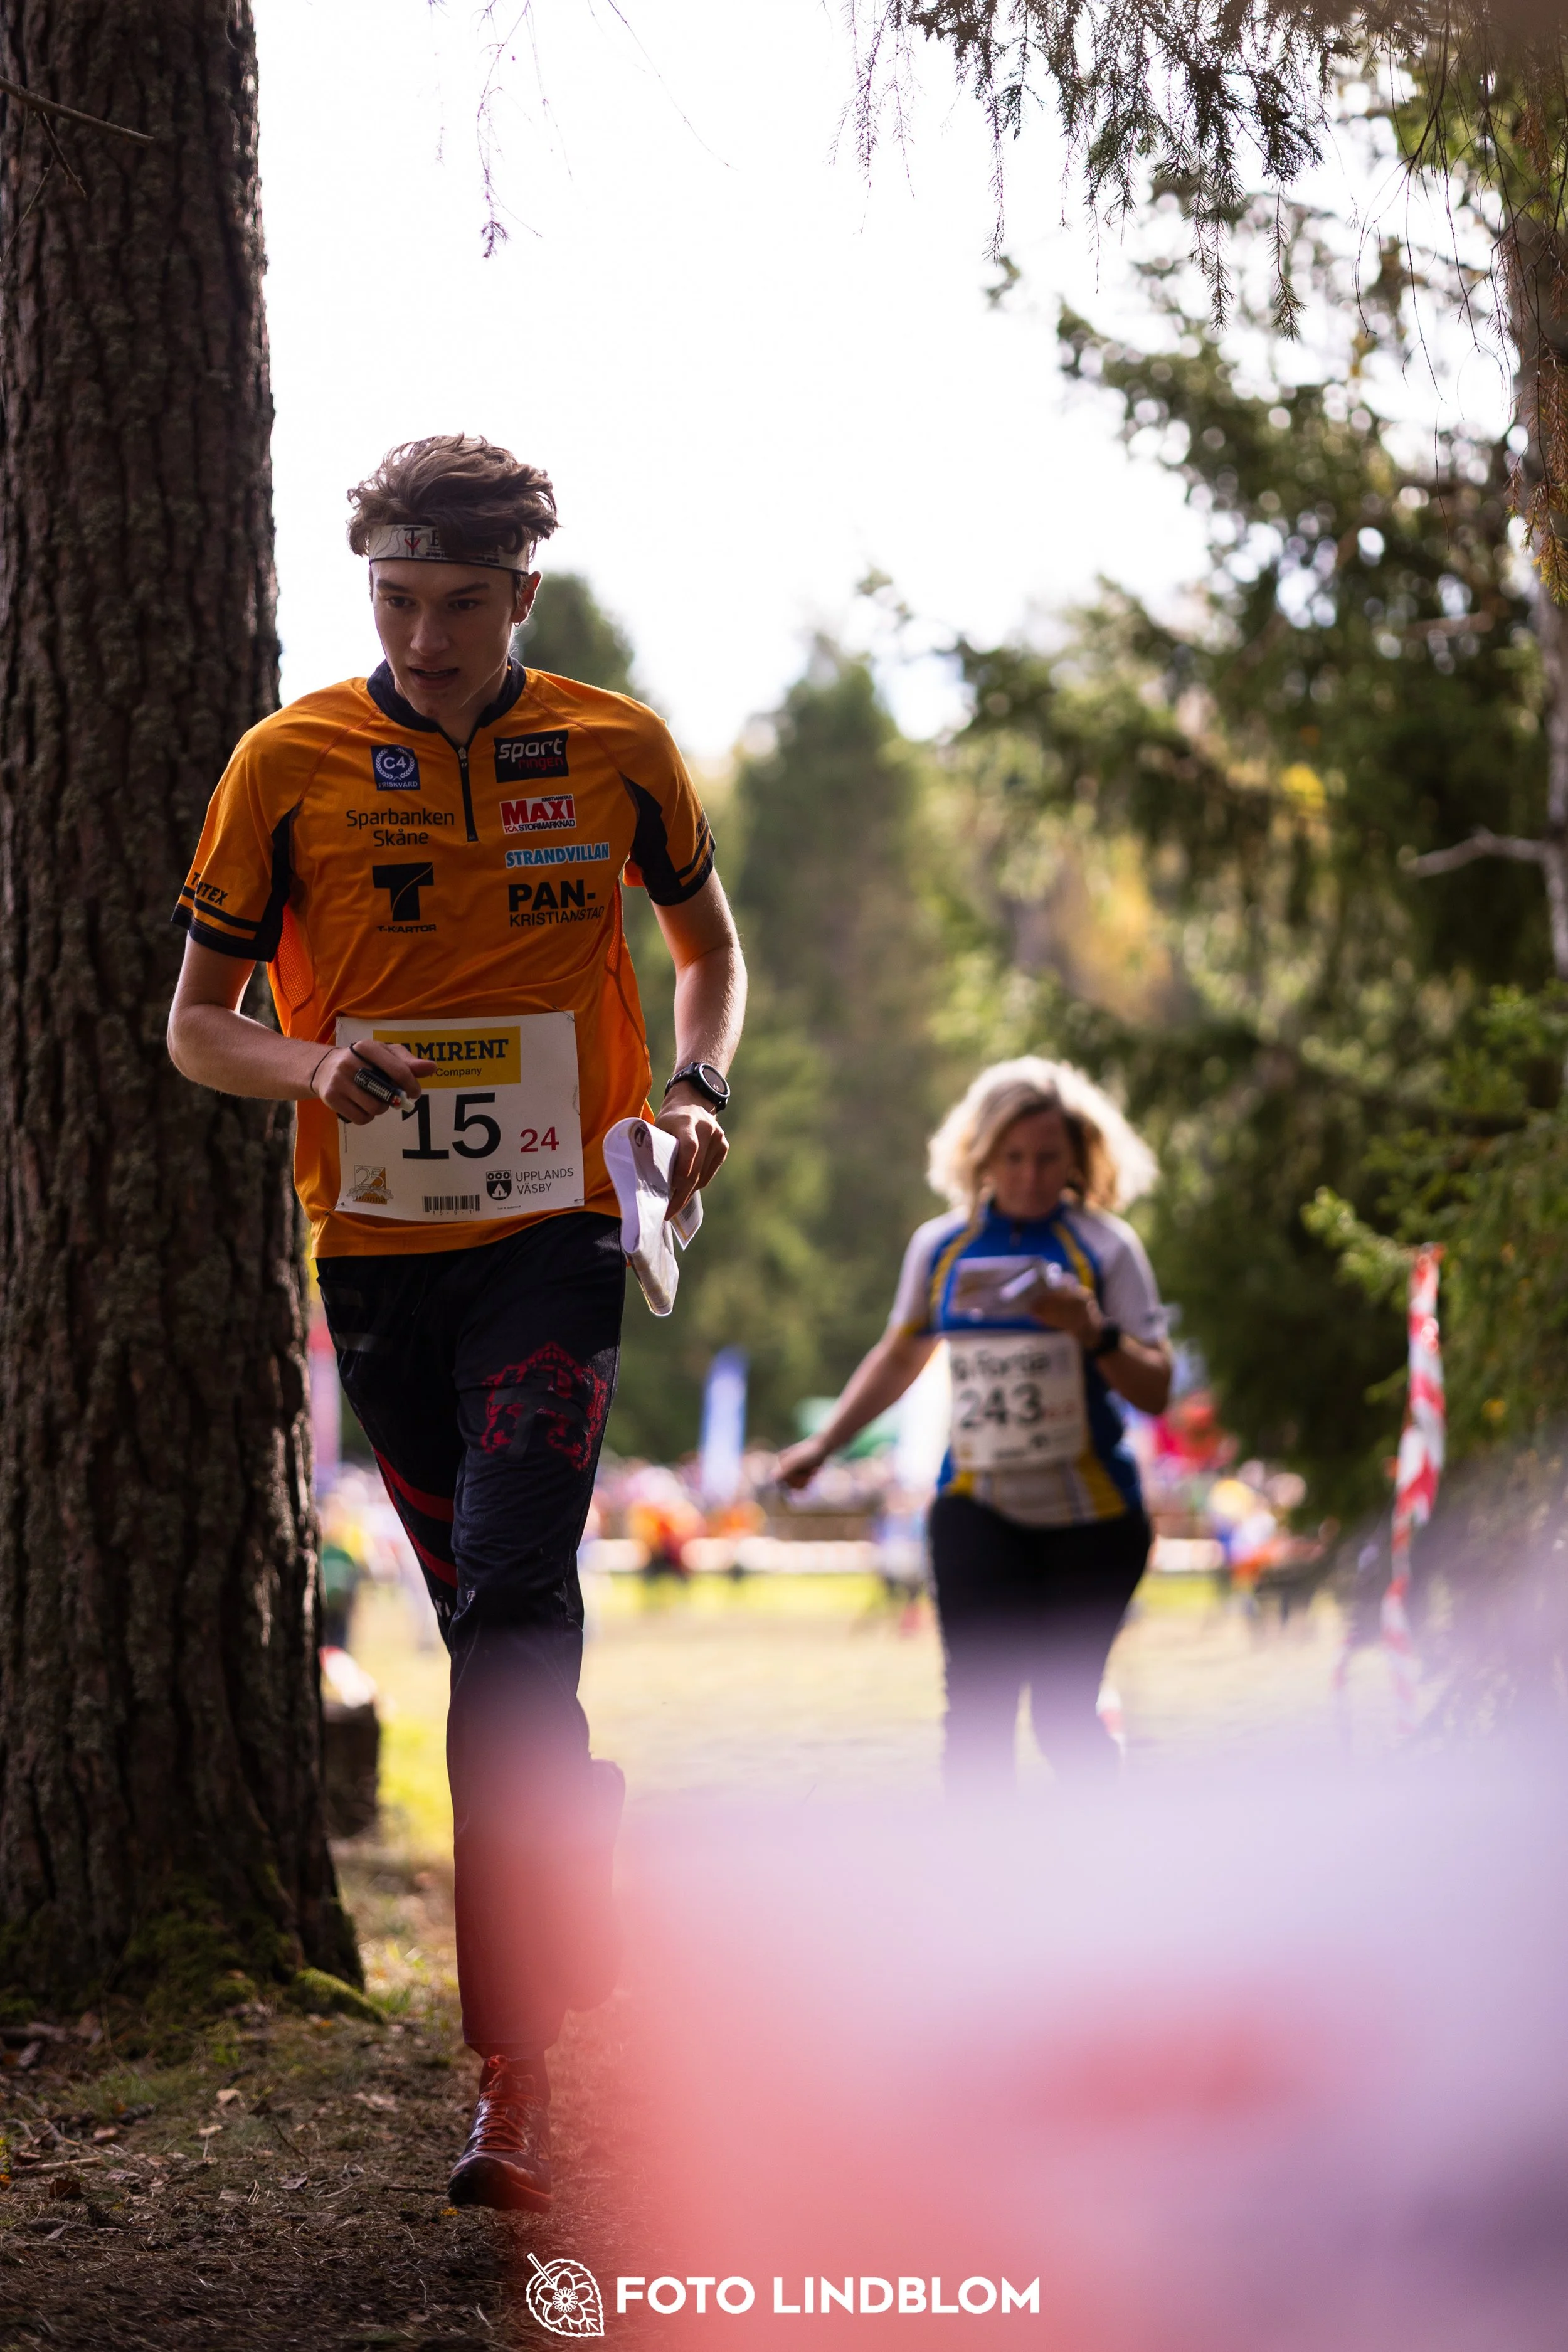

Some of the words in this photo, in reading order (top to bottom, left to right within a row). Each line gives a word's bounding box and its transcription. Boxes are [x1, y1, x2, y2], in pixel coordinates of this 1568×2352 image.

[498, 738, 563, 763] sport
[383, 756, 406, 770] C4
[519, 757, 564, 770] ringen
[346, 807, 454, 830] Sparbanken
[501, 800, 575, 826] MAXI
[518, 819, 576, 832] STORMARKNAD
[374, 828, 429, 847] Skåne
[506, 843, 610, 868] STRANDVILLAN
[509, 906, 605, 928] KRISTIANSTAD
[377, 924, 437, 933] T-KARTOR
[384, 1039, 509, 1062] MIRENT
[435, 1067, 482, 1078] Company
[401, 1092, 501, 1160] 15
[520, 1126, 560, 1153] 24
[356, 1167, 384, 1188] 25
[516, 1167, 574, 1182] UPPLANDS
[517, 1182, 552, 1195] VÄSBY
[960, 1382, 1044, 1429] 243
